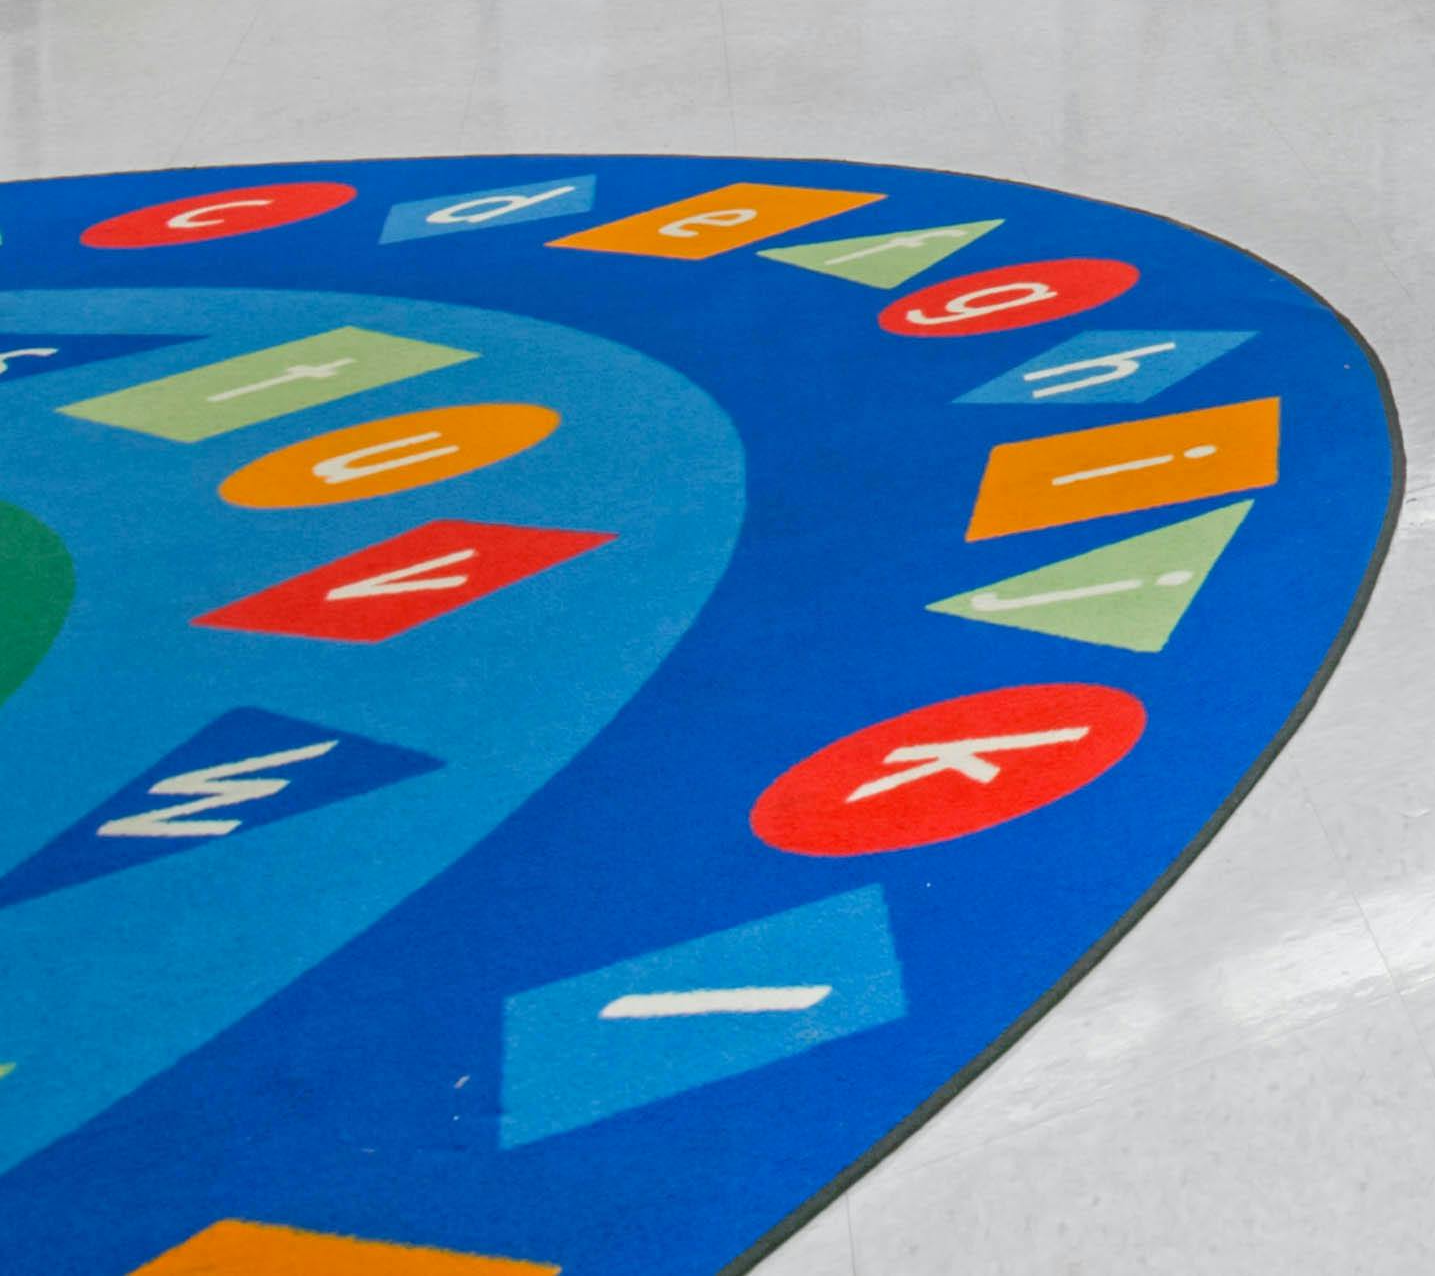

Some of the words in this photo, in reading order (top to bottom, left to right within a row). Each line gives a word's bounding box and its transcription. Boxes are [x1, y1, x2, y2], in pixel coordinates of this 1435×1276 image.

[425, 186, 578, 224] d
[656, 206, 757, 240] e
[824, 228, 968, 265] f
[907, 280, 1056, 325] g
[206, 358, 359, 402] t
[1023, 342, 1176, 398] h
[312, 431, 461, 486] u
[1052, 445, 1217, 485] i
[970, 568, 1194, 612] j
